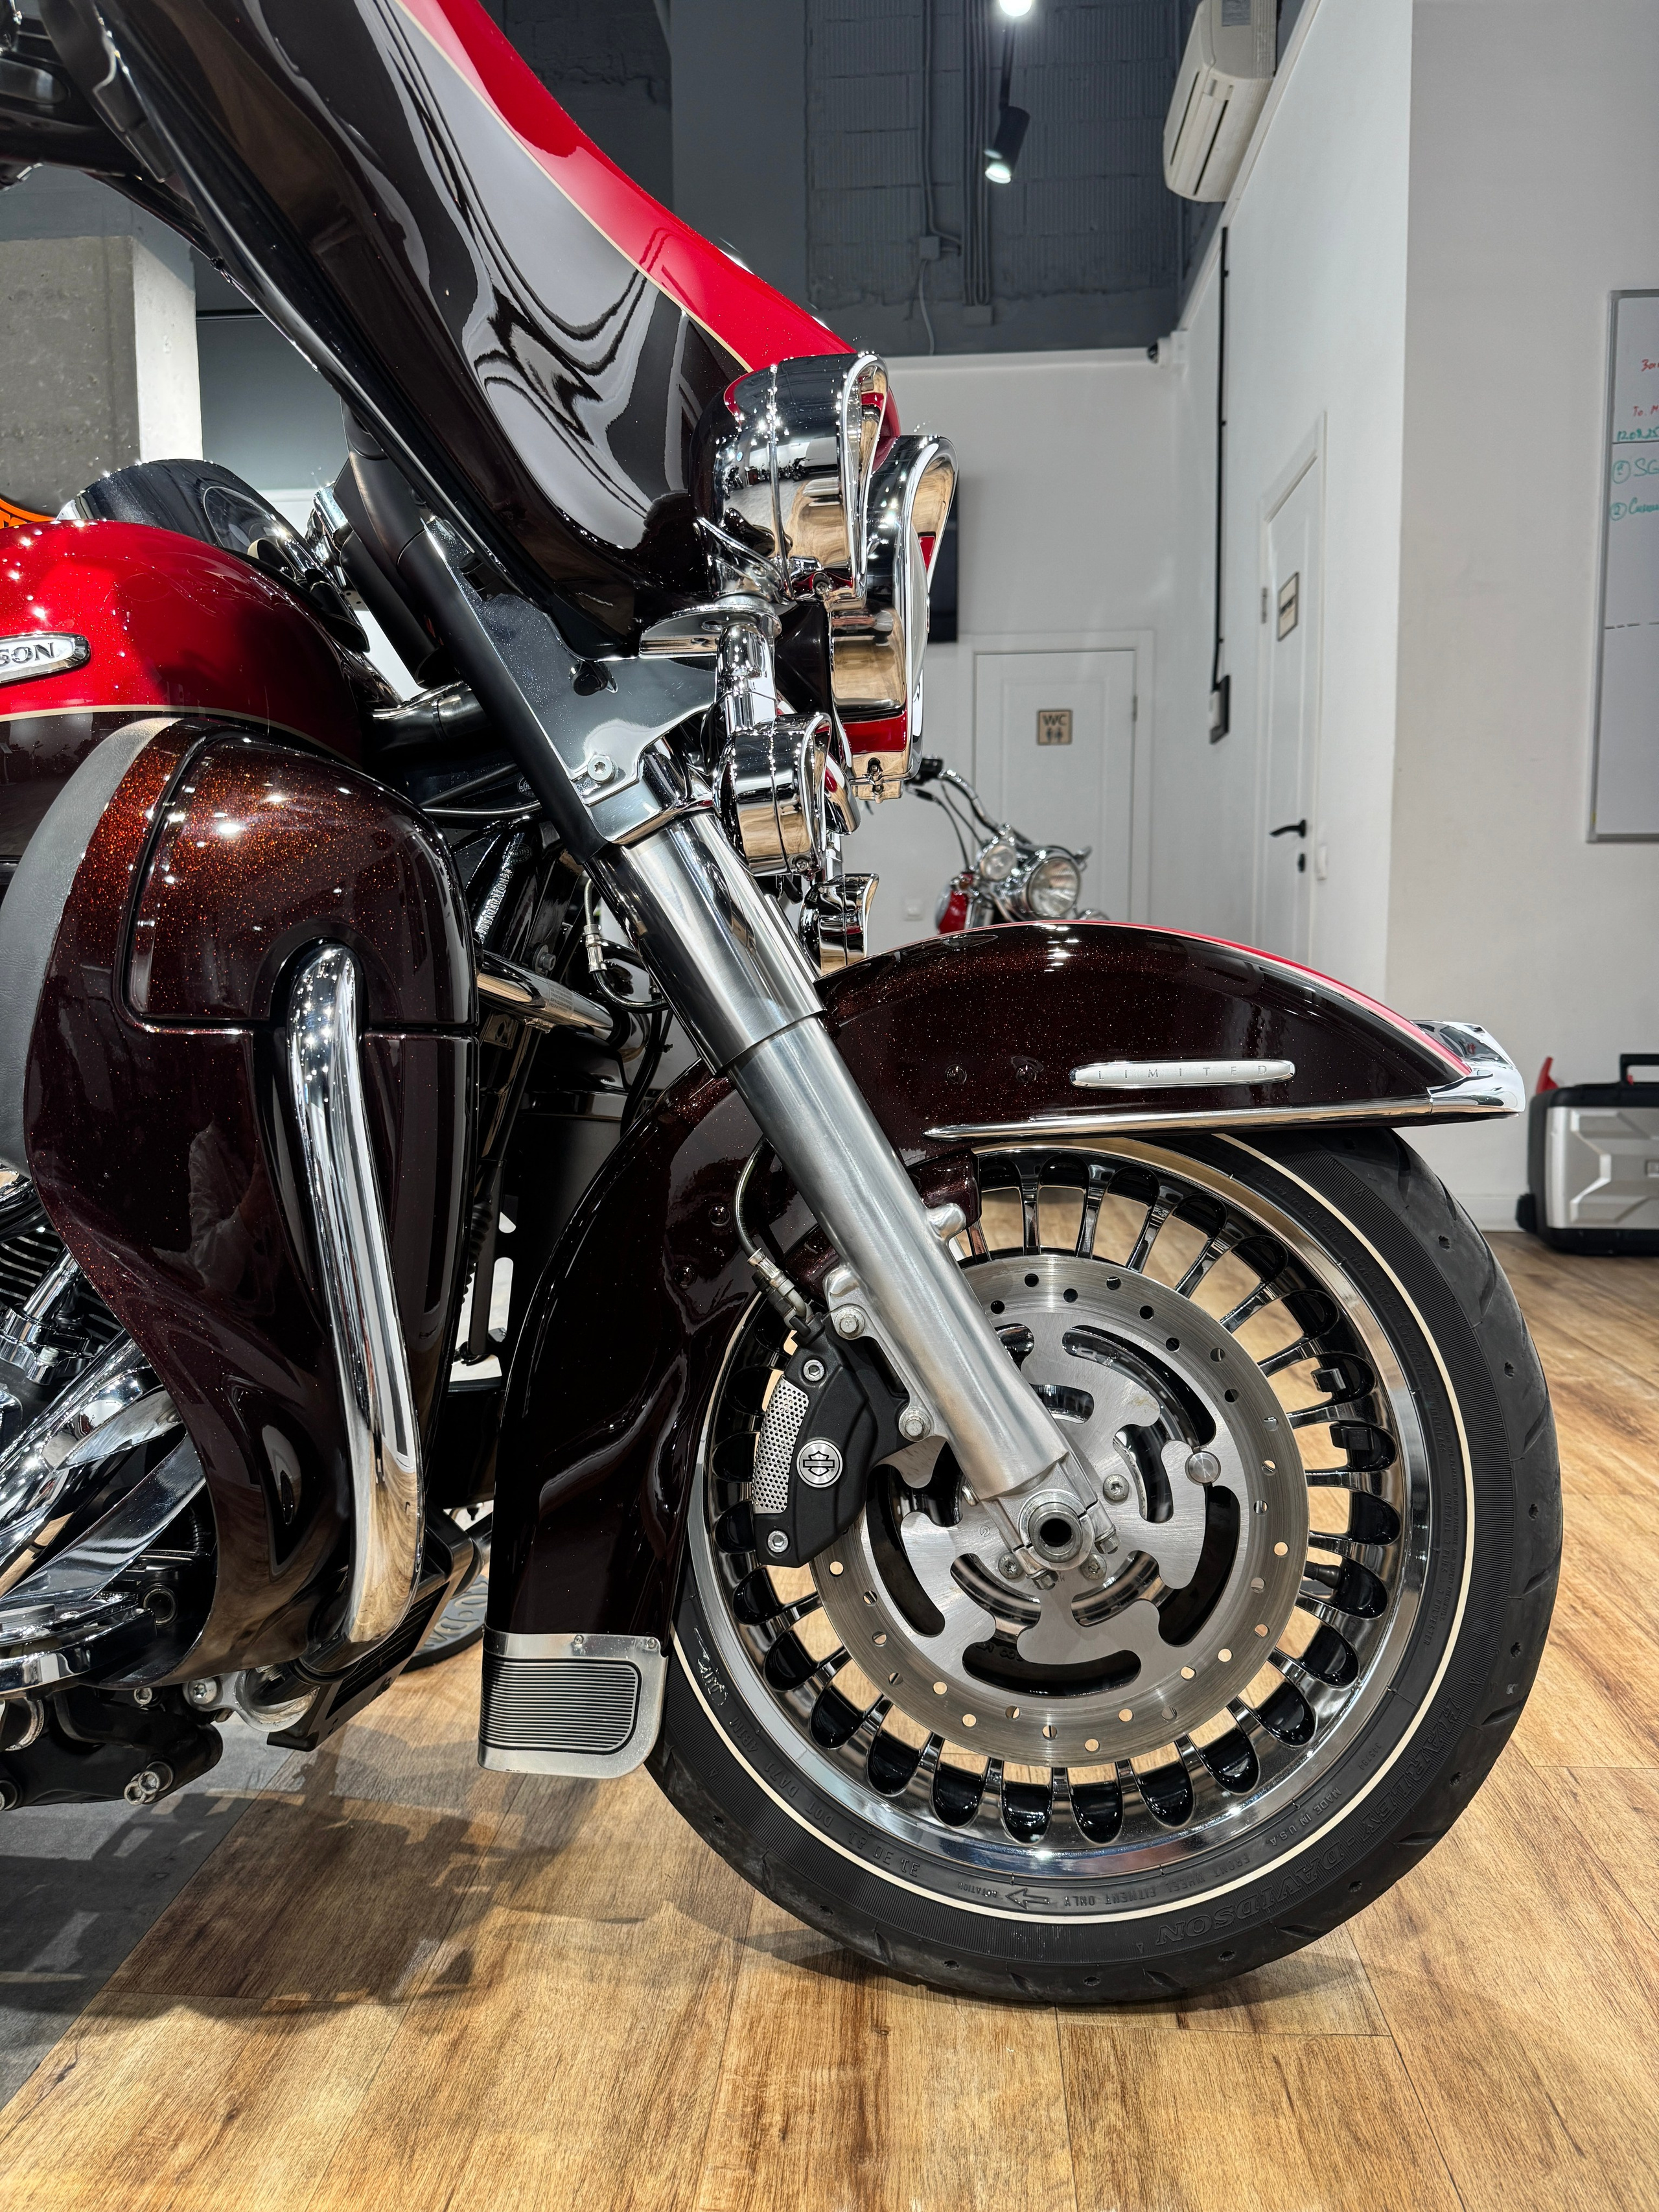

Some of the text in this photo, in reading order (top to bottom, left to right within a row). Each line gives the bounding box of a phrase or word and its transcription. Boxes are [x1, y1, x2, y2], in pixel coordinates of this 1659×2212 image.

[1041, 714, 1067, 726] WC
[1098, 1065, 1268, 1080] LIMITED
[1422, 1598, 1442, 1646] POLYESTER
[762, 1760, 801, 1799] DA71
[804, 1799, 835, 1828] DOT
[1264, 1787, 1342, 1850] MADE IN U.S.A.
[1211, 1852, 1250, 1877] FRONT
[1165, 1872, 1205, 1892] WHEEL
[1063, 1895, 1095, 1906] ONLY
